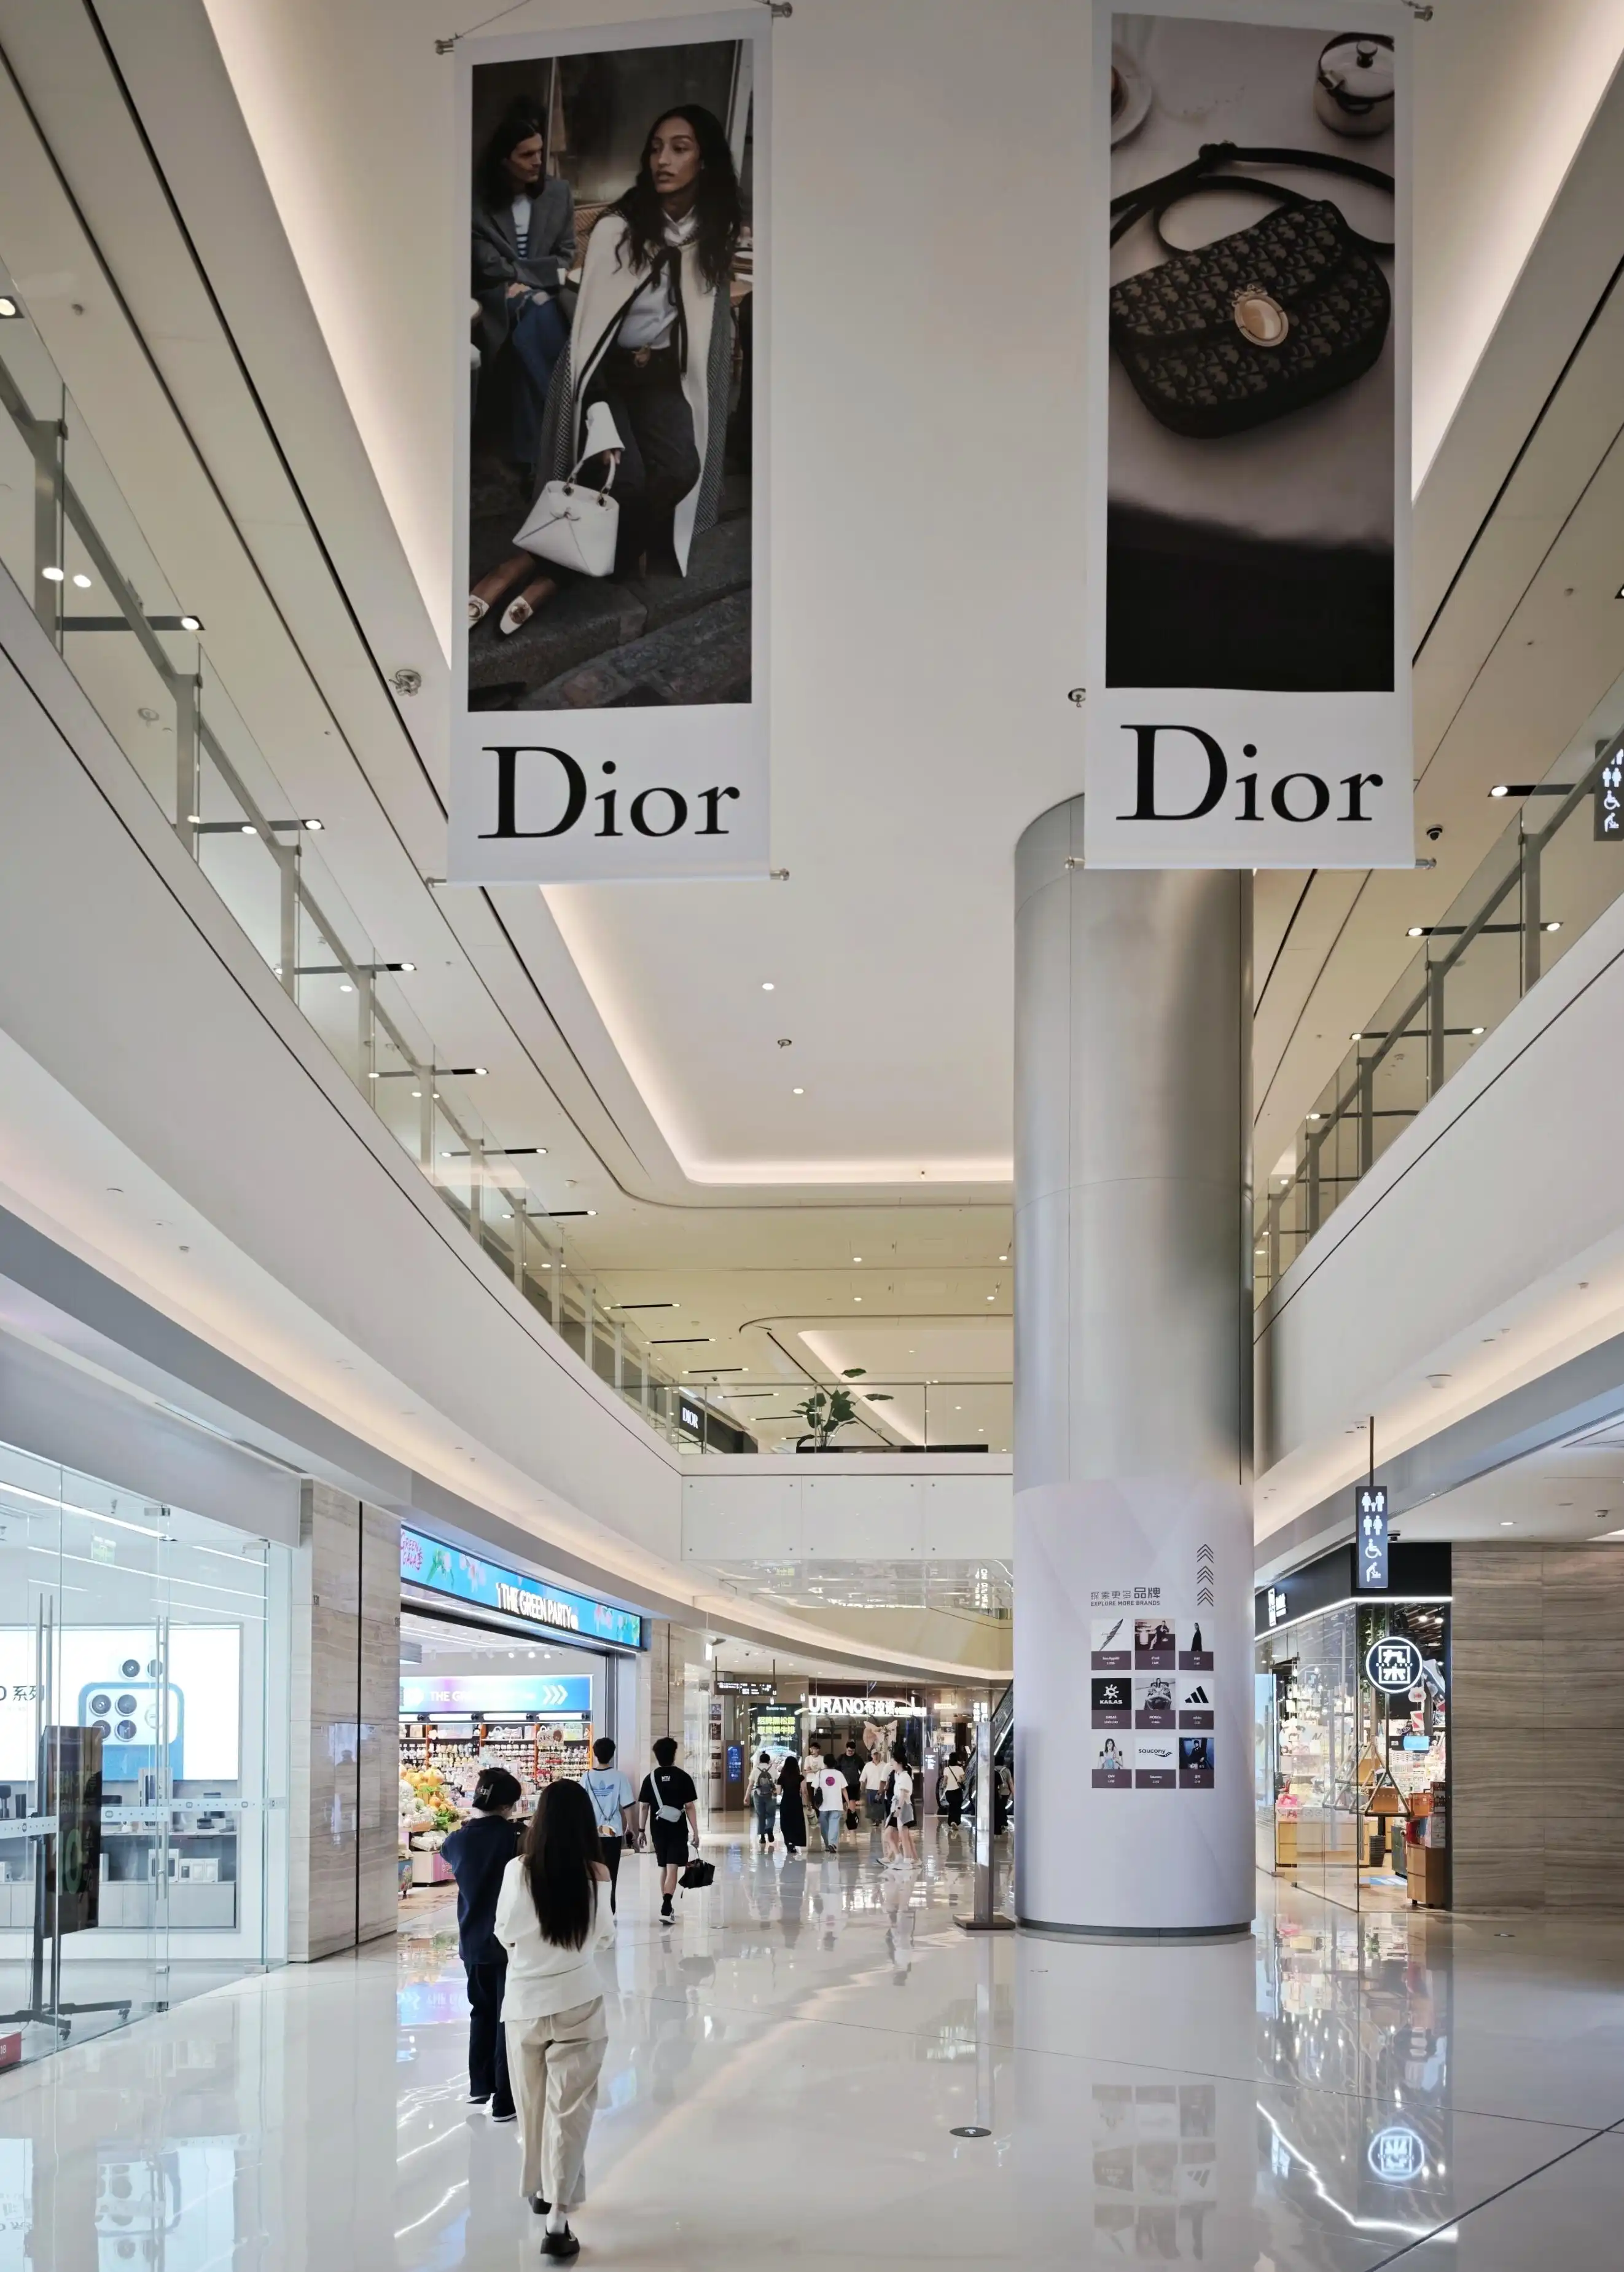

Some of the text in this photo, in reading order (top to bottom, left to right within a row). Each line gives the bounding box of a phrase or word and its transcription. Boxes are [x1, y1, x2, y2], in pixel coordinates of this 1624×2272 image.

[1116, 724, 1383, 822] Dior
[477, 746, 740, 839] Dior
[682, 1407, 698, 1429] DIOR
[501, 1583, 520, 1614] THE
[519, 1589, 547, 1622] GREEN
[547, 1599, 572, 1629] PARTY
[1091, 1586, 1160, 1600] 探索更多品牌
[430, 1691, 450, 1702] THE
